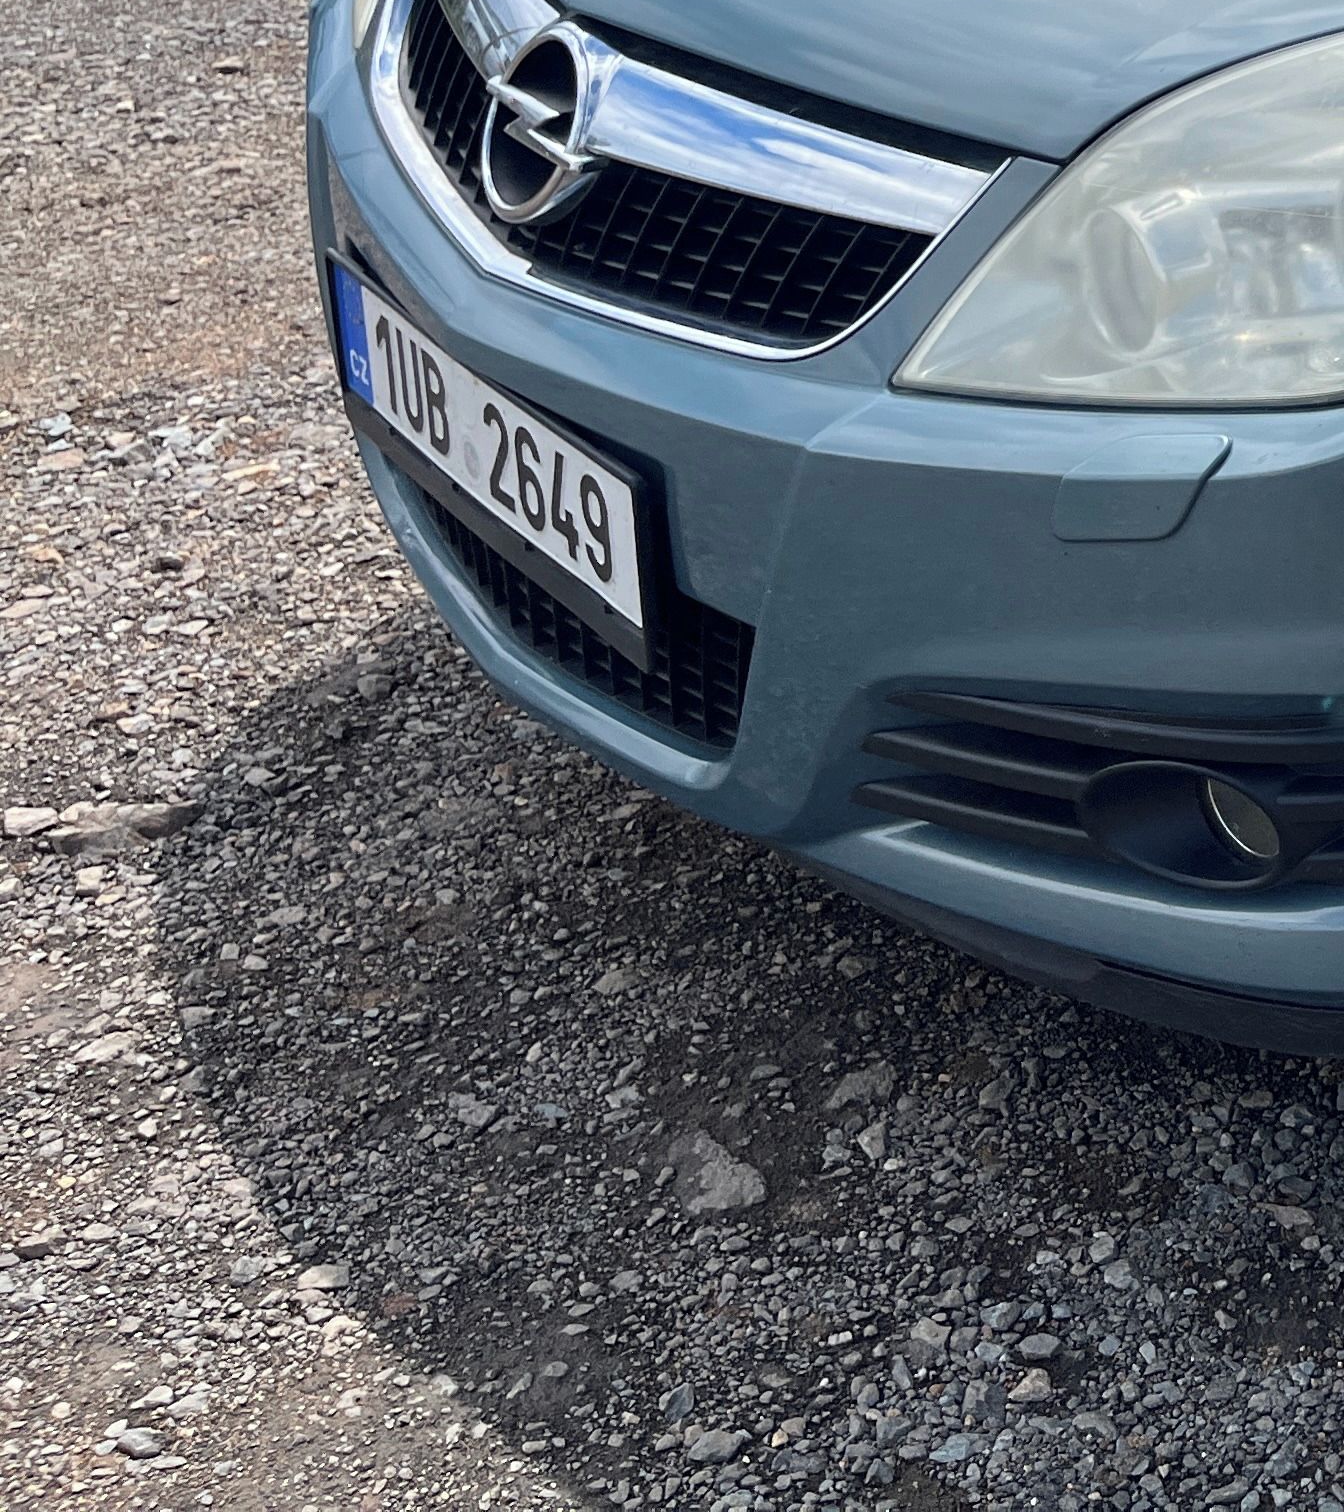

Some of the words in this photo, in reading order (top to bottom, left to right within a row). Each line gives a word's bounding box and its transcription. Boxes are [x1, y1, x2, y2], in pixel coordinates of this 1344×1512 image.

[349, 348, 370, 387] CZ
[375, 314, 451, 457] 1UB
[482, 402, 614, 584] 2649
